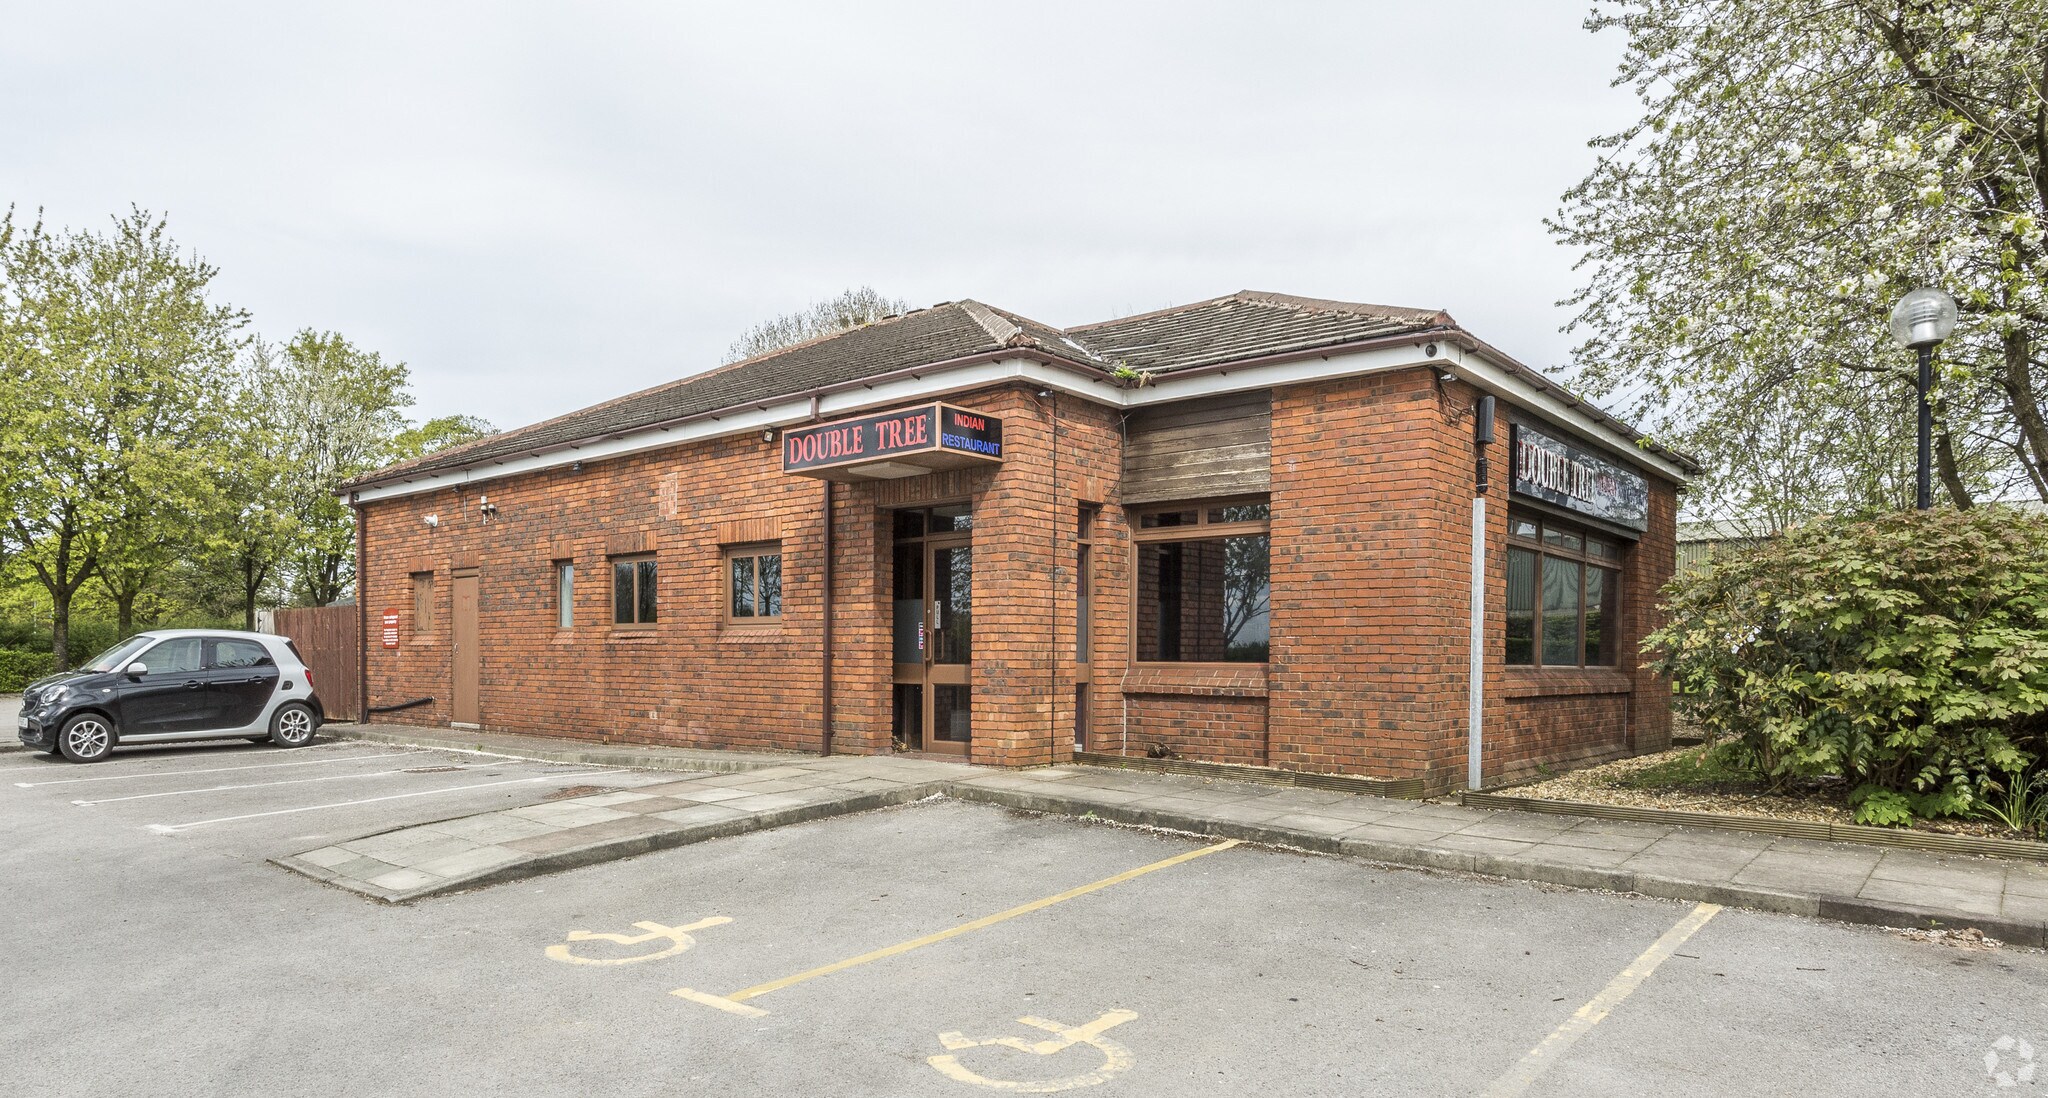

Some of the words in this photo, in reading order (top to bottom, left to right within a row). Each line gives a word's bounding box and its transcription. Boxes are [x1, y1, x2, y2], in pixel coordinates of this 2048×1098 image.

[789, 427, 863, 464] DOUBLE
[876, 415, 928, 450] TREE
[954, 413, 985, 431] INDIAN
[942, 433, 1000, 455] RESTAURANT
[1518, 439, 1569, 496] DOUBLE
